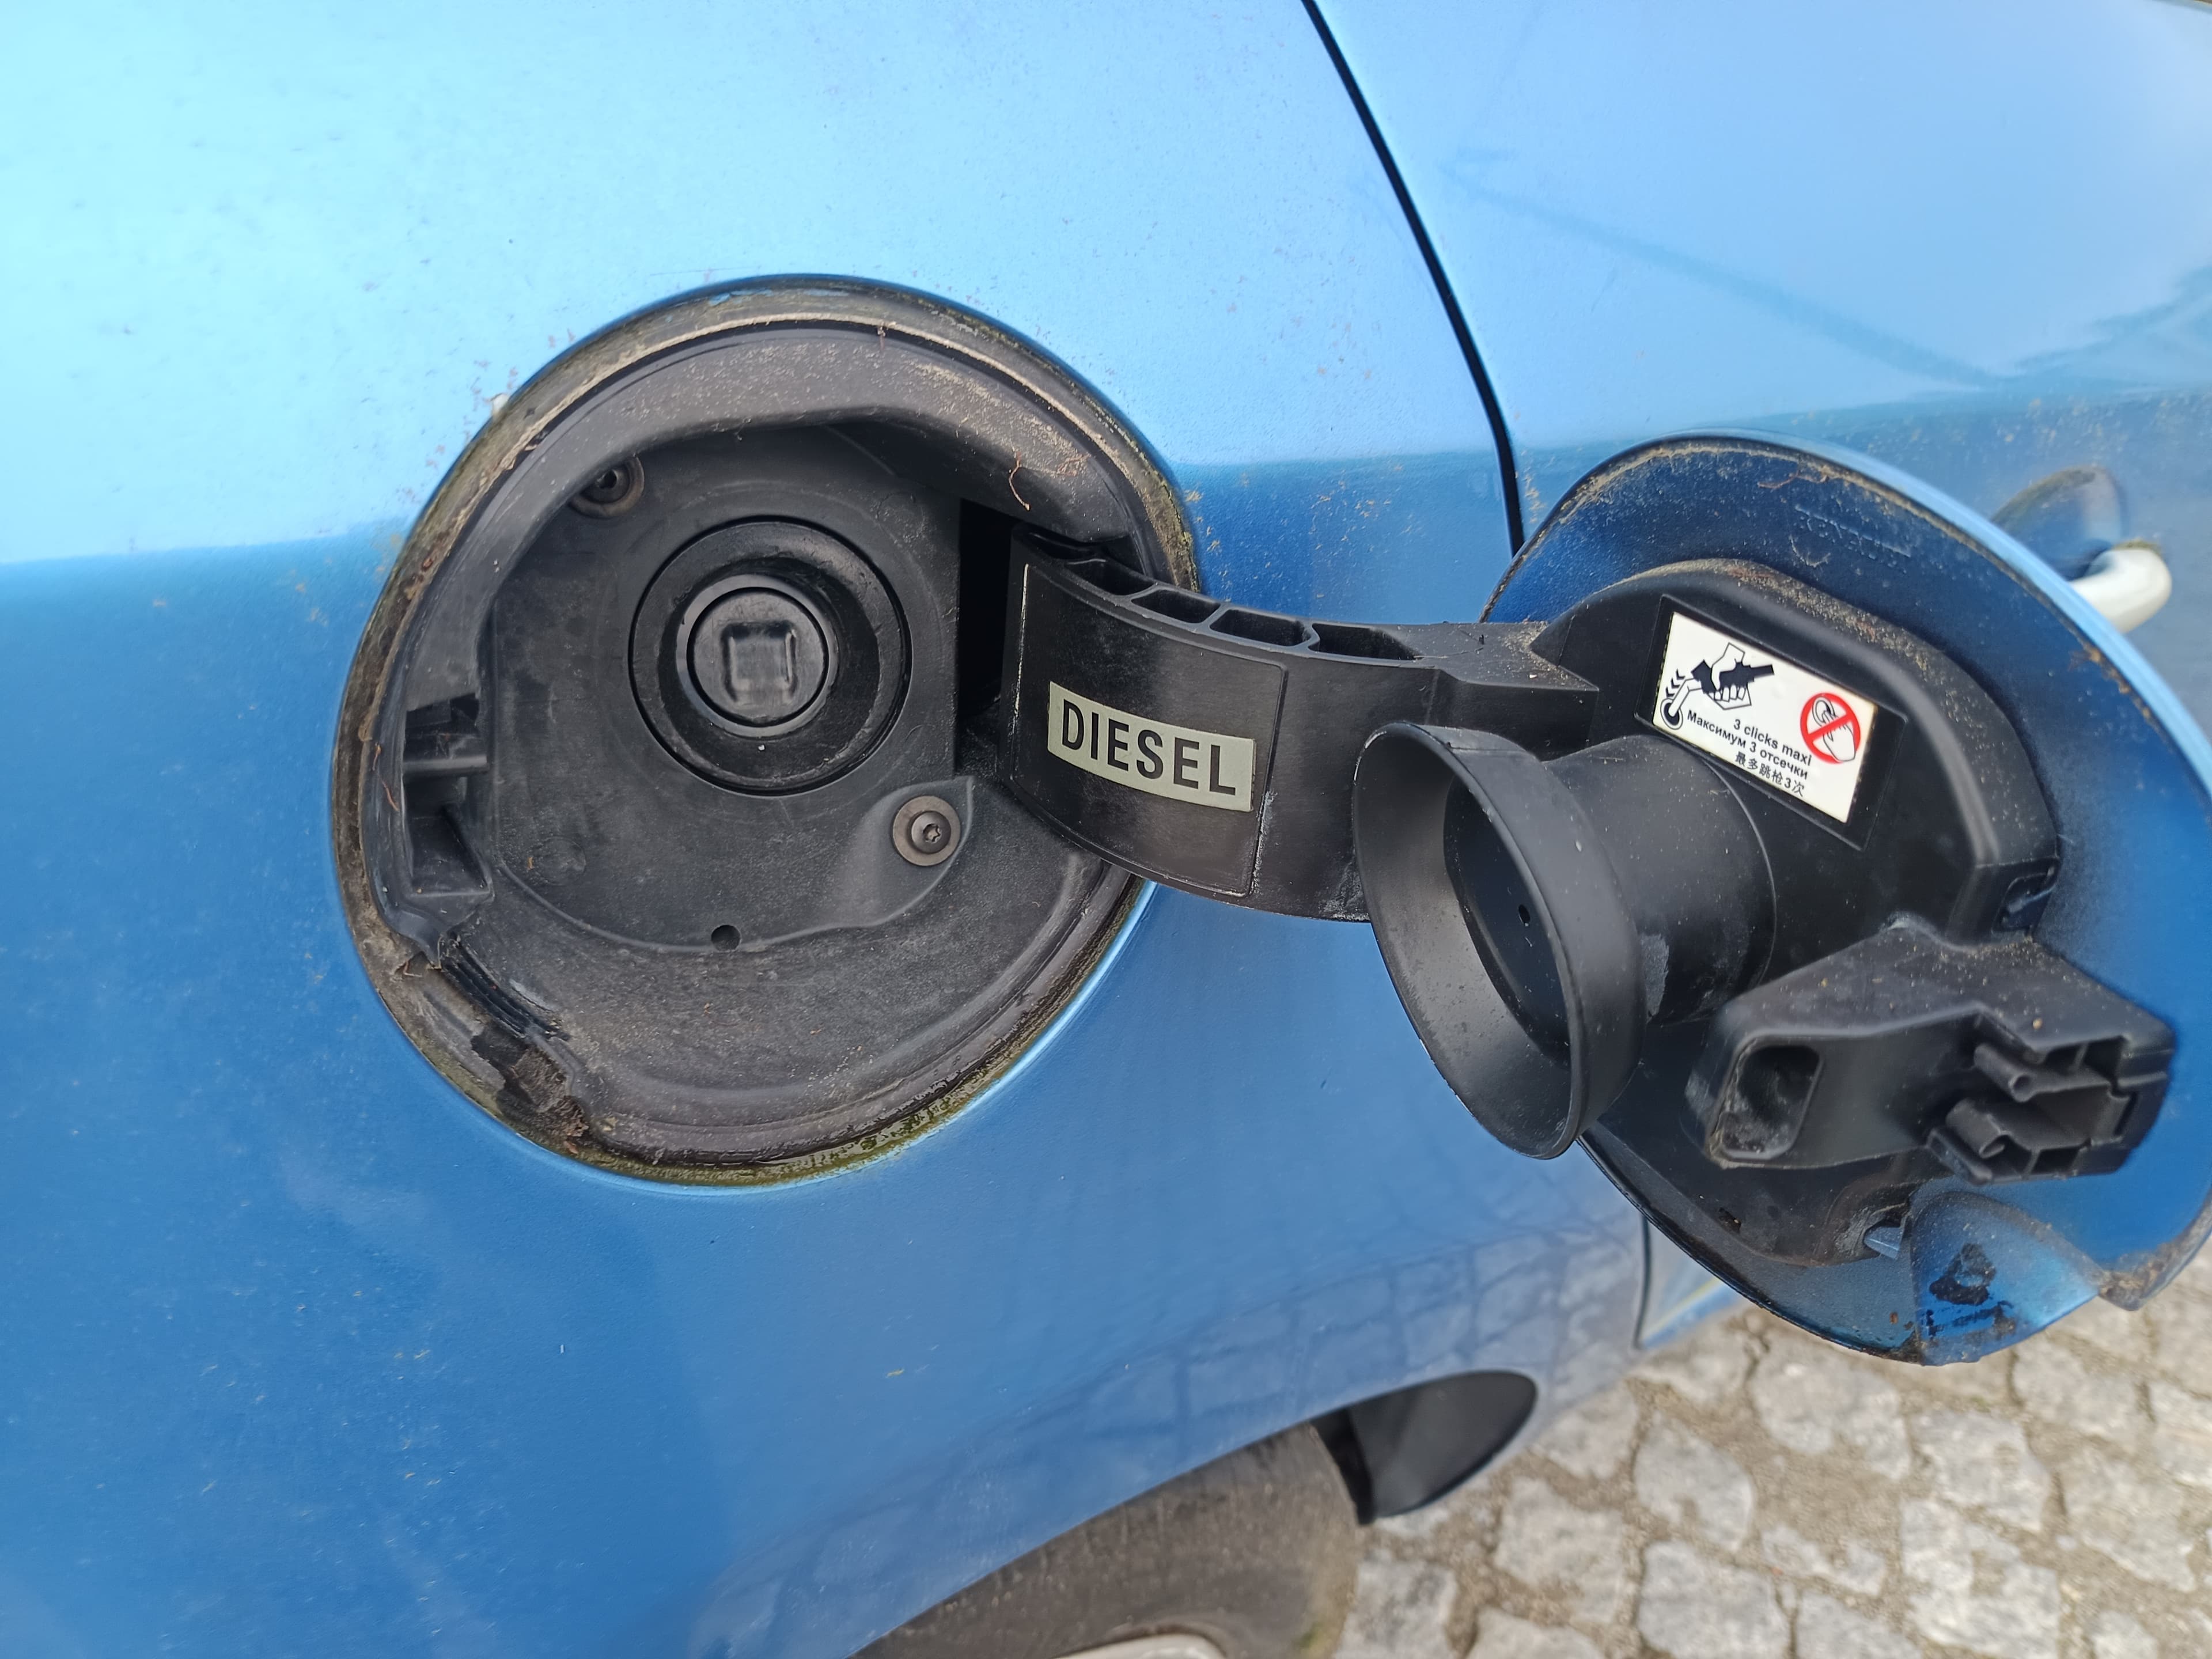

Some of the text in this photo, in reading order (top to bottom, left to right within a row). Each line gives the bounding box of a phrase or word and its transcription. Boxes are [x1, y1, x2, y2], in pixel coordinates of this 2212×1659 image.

[1062, 699, 1236, 796] DIESEL
[1687, 710, 1808, 780] Максимум 3 отсечки
[1733, 719, 1812, 766] 3 clicks maxi
[1736, 752, 1805, 797] 最多跳枪3次
